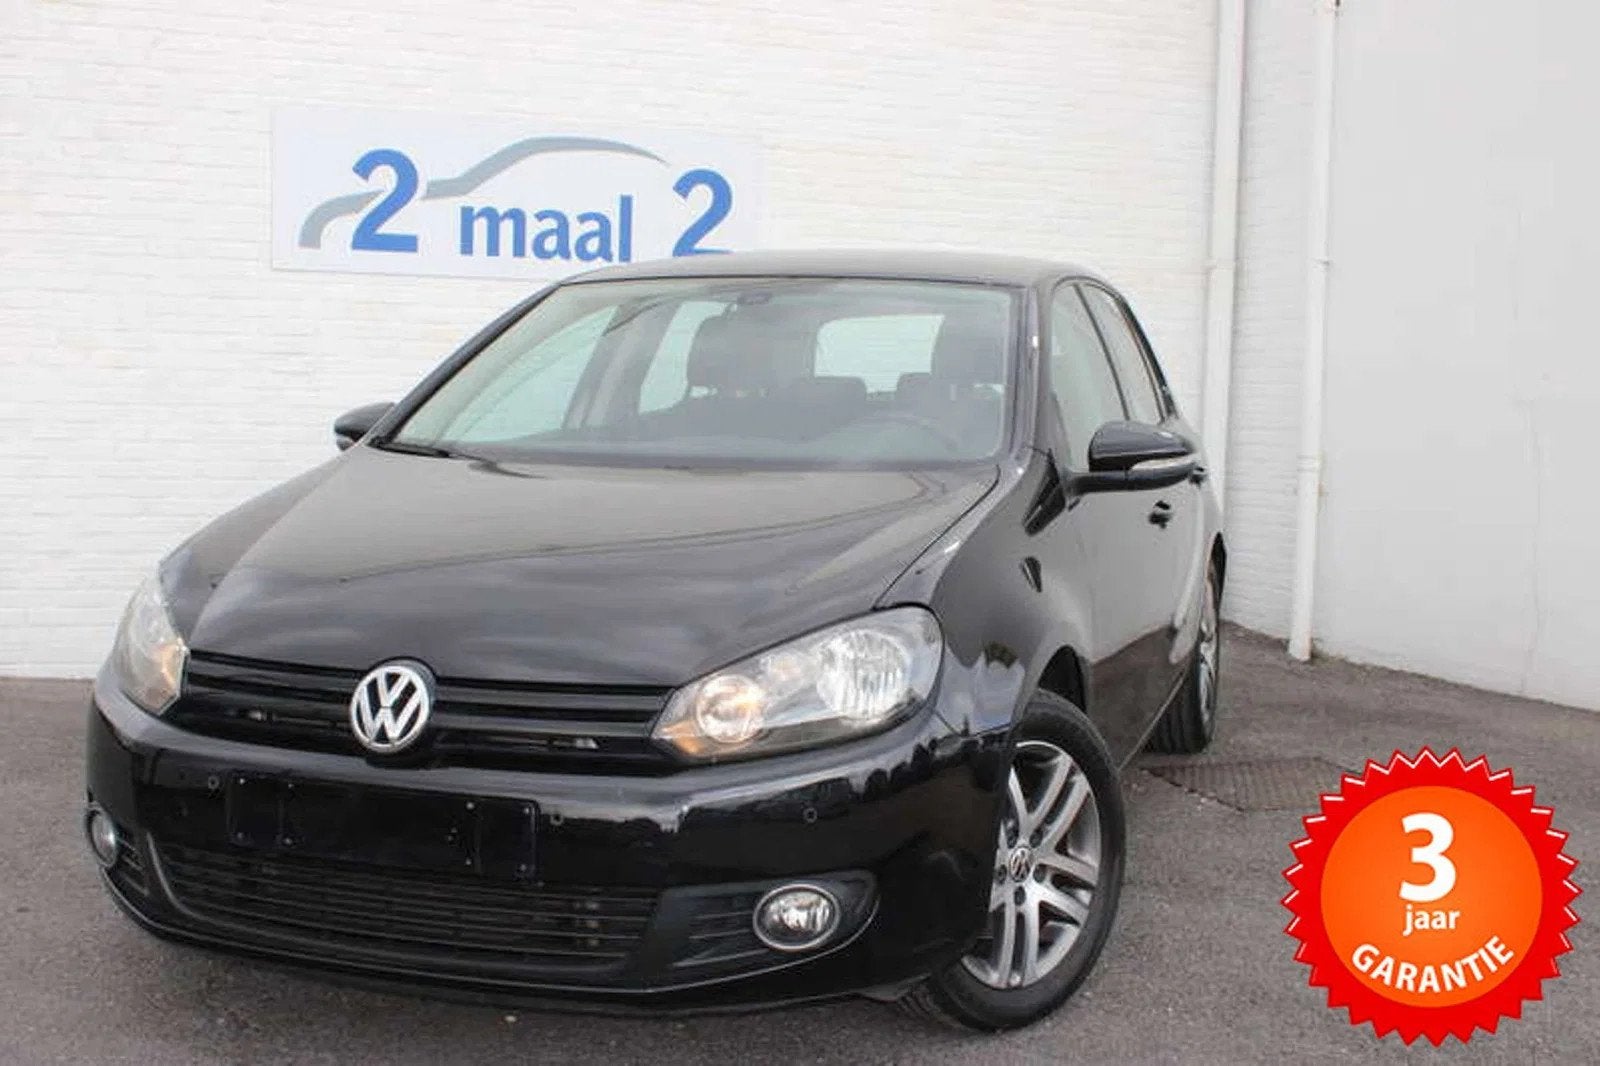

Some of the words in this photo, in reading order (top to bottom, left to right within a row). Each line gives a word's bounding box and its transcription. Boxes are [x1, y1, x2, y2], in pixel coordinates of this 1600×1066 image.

[351, 149, 419, 253] 2
[459, 194, 633, 263] maal
[672, 168, 734, 255] 2
[353, 666, 428, 746] VW
